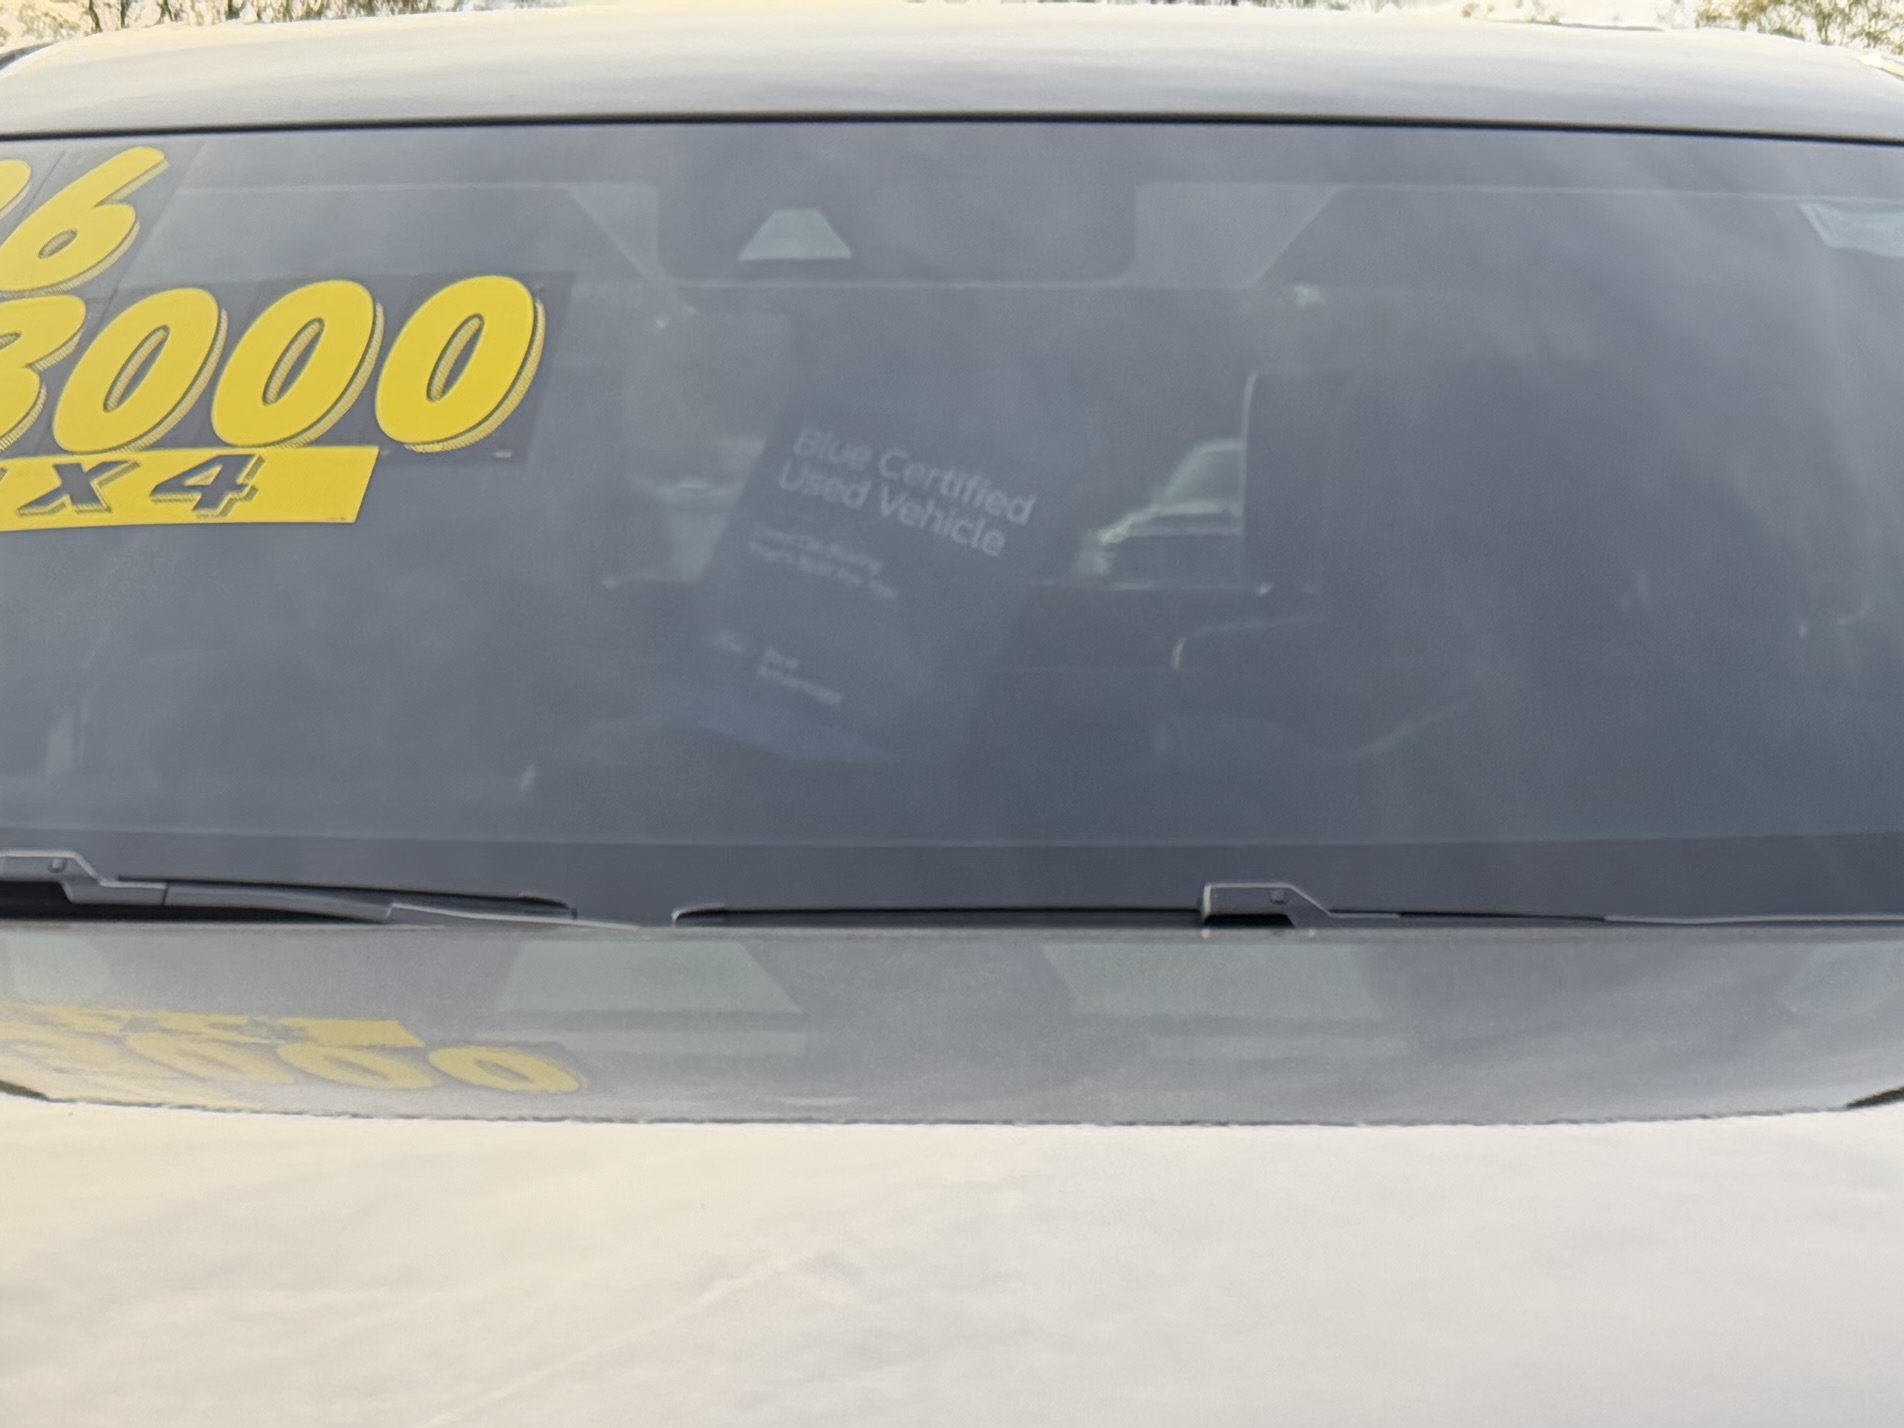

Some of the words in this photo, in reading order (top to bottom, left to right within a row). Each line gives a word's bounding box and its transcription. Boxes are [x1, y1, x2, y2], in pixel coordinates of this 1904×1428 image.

[779, 459, 871, 510] Used
[880, 483, 1005, 557] Vehicle
[793, 427, 873, 471] Blue
[878, 448, 1037, 526] Certified
